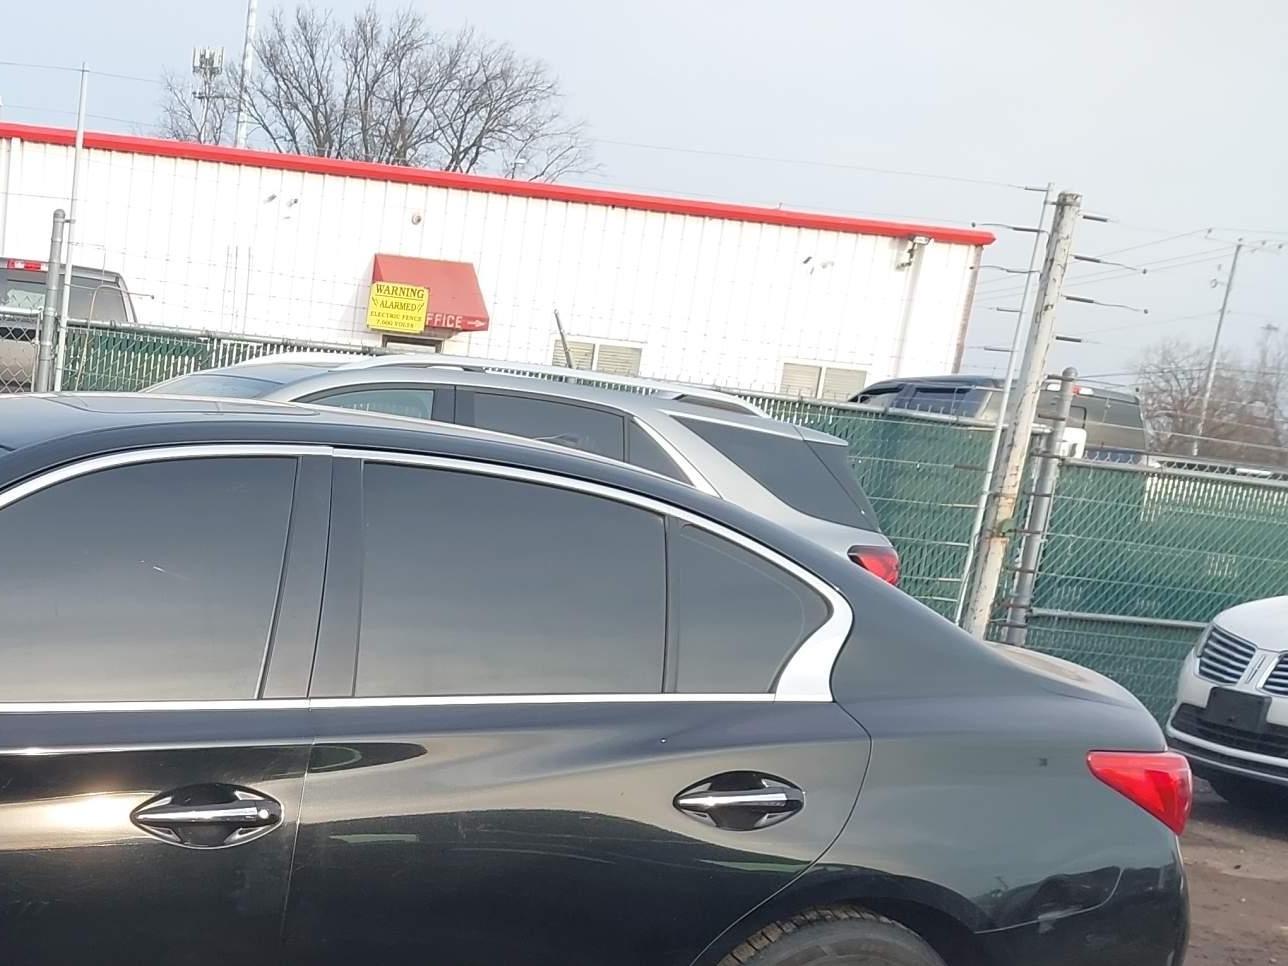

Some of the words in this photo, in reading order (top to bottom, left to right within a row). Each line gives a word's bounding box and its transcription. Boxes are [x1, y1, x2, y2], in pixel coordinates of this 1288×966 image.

[376, 284, 425, 299] WARNING
[380, 300, 417, 312] ALARMED
[426, 313, 463, 328] FFICE
